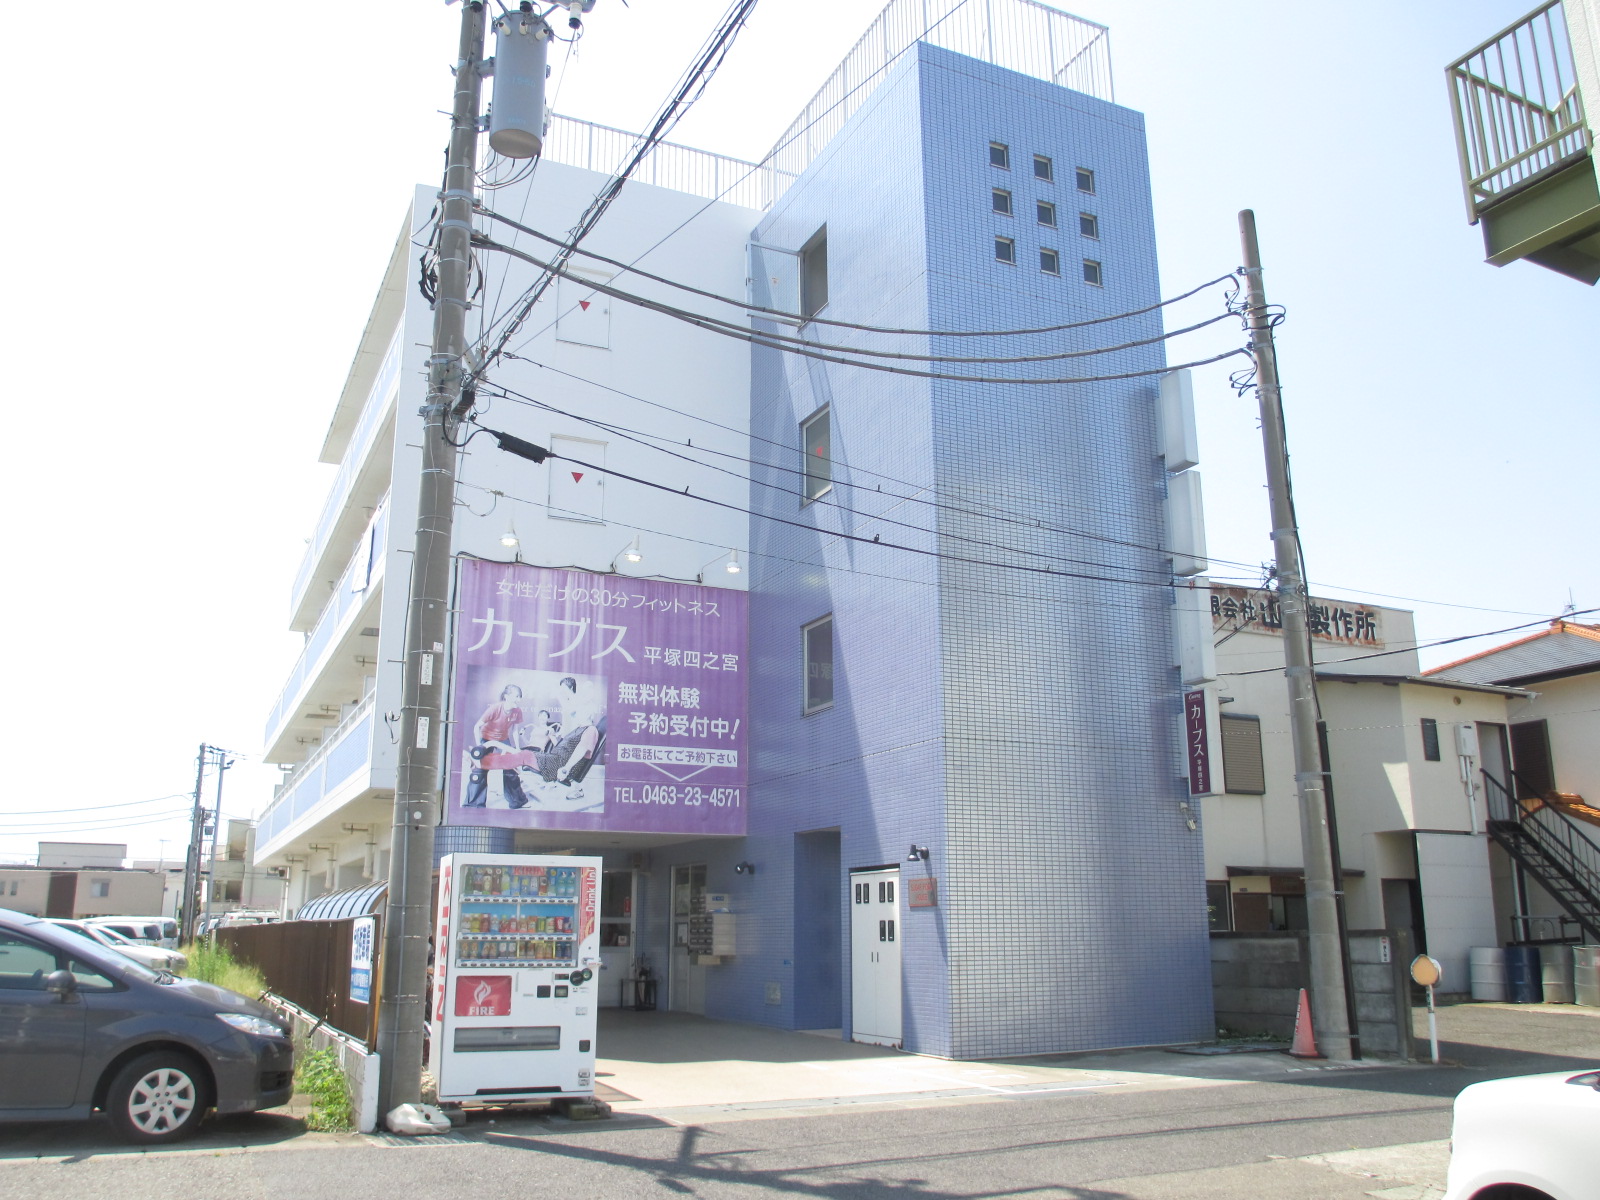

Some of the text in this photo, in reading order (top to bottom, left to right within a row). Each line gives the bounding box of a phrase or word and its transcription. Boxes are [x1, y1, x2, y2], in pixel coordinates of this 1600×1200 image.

[495, 579, 721, 618] 女性だけの30分フィットネス
[467, 607, 636, 663] カーブス
[644, 646, 739, 672] 平塚四之宮
[618, 682, 701, 709] 無料体験
[1191, 704, 1204, 757] カーブス
[620, 747, 737, 765] お電話にてご予約下さい
[585, 887, 595, 912] Drink
[469, 1006, 495, 1015] FIRE
